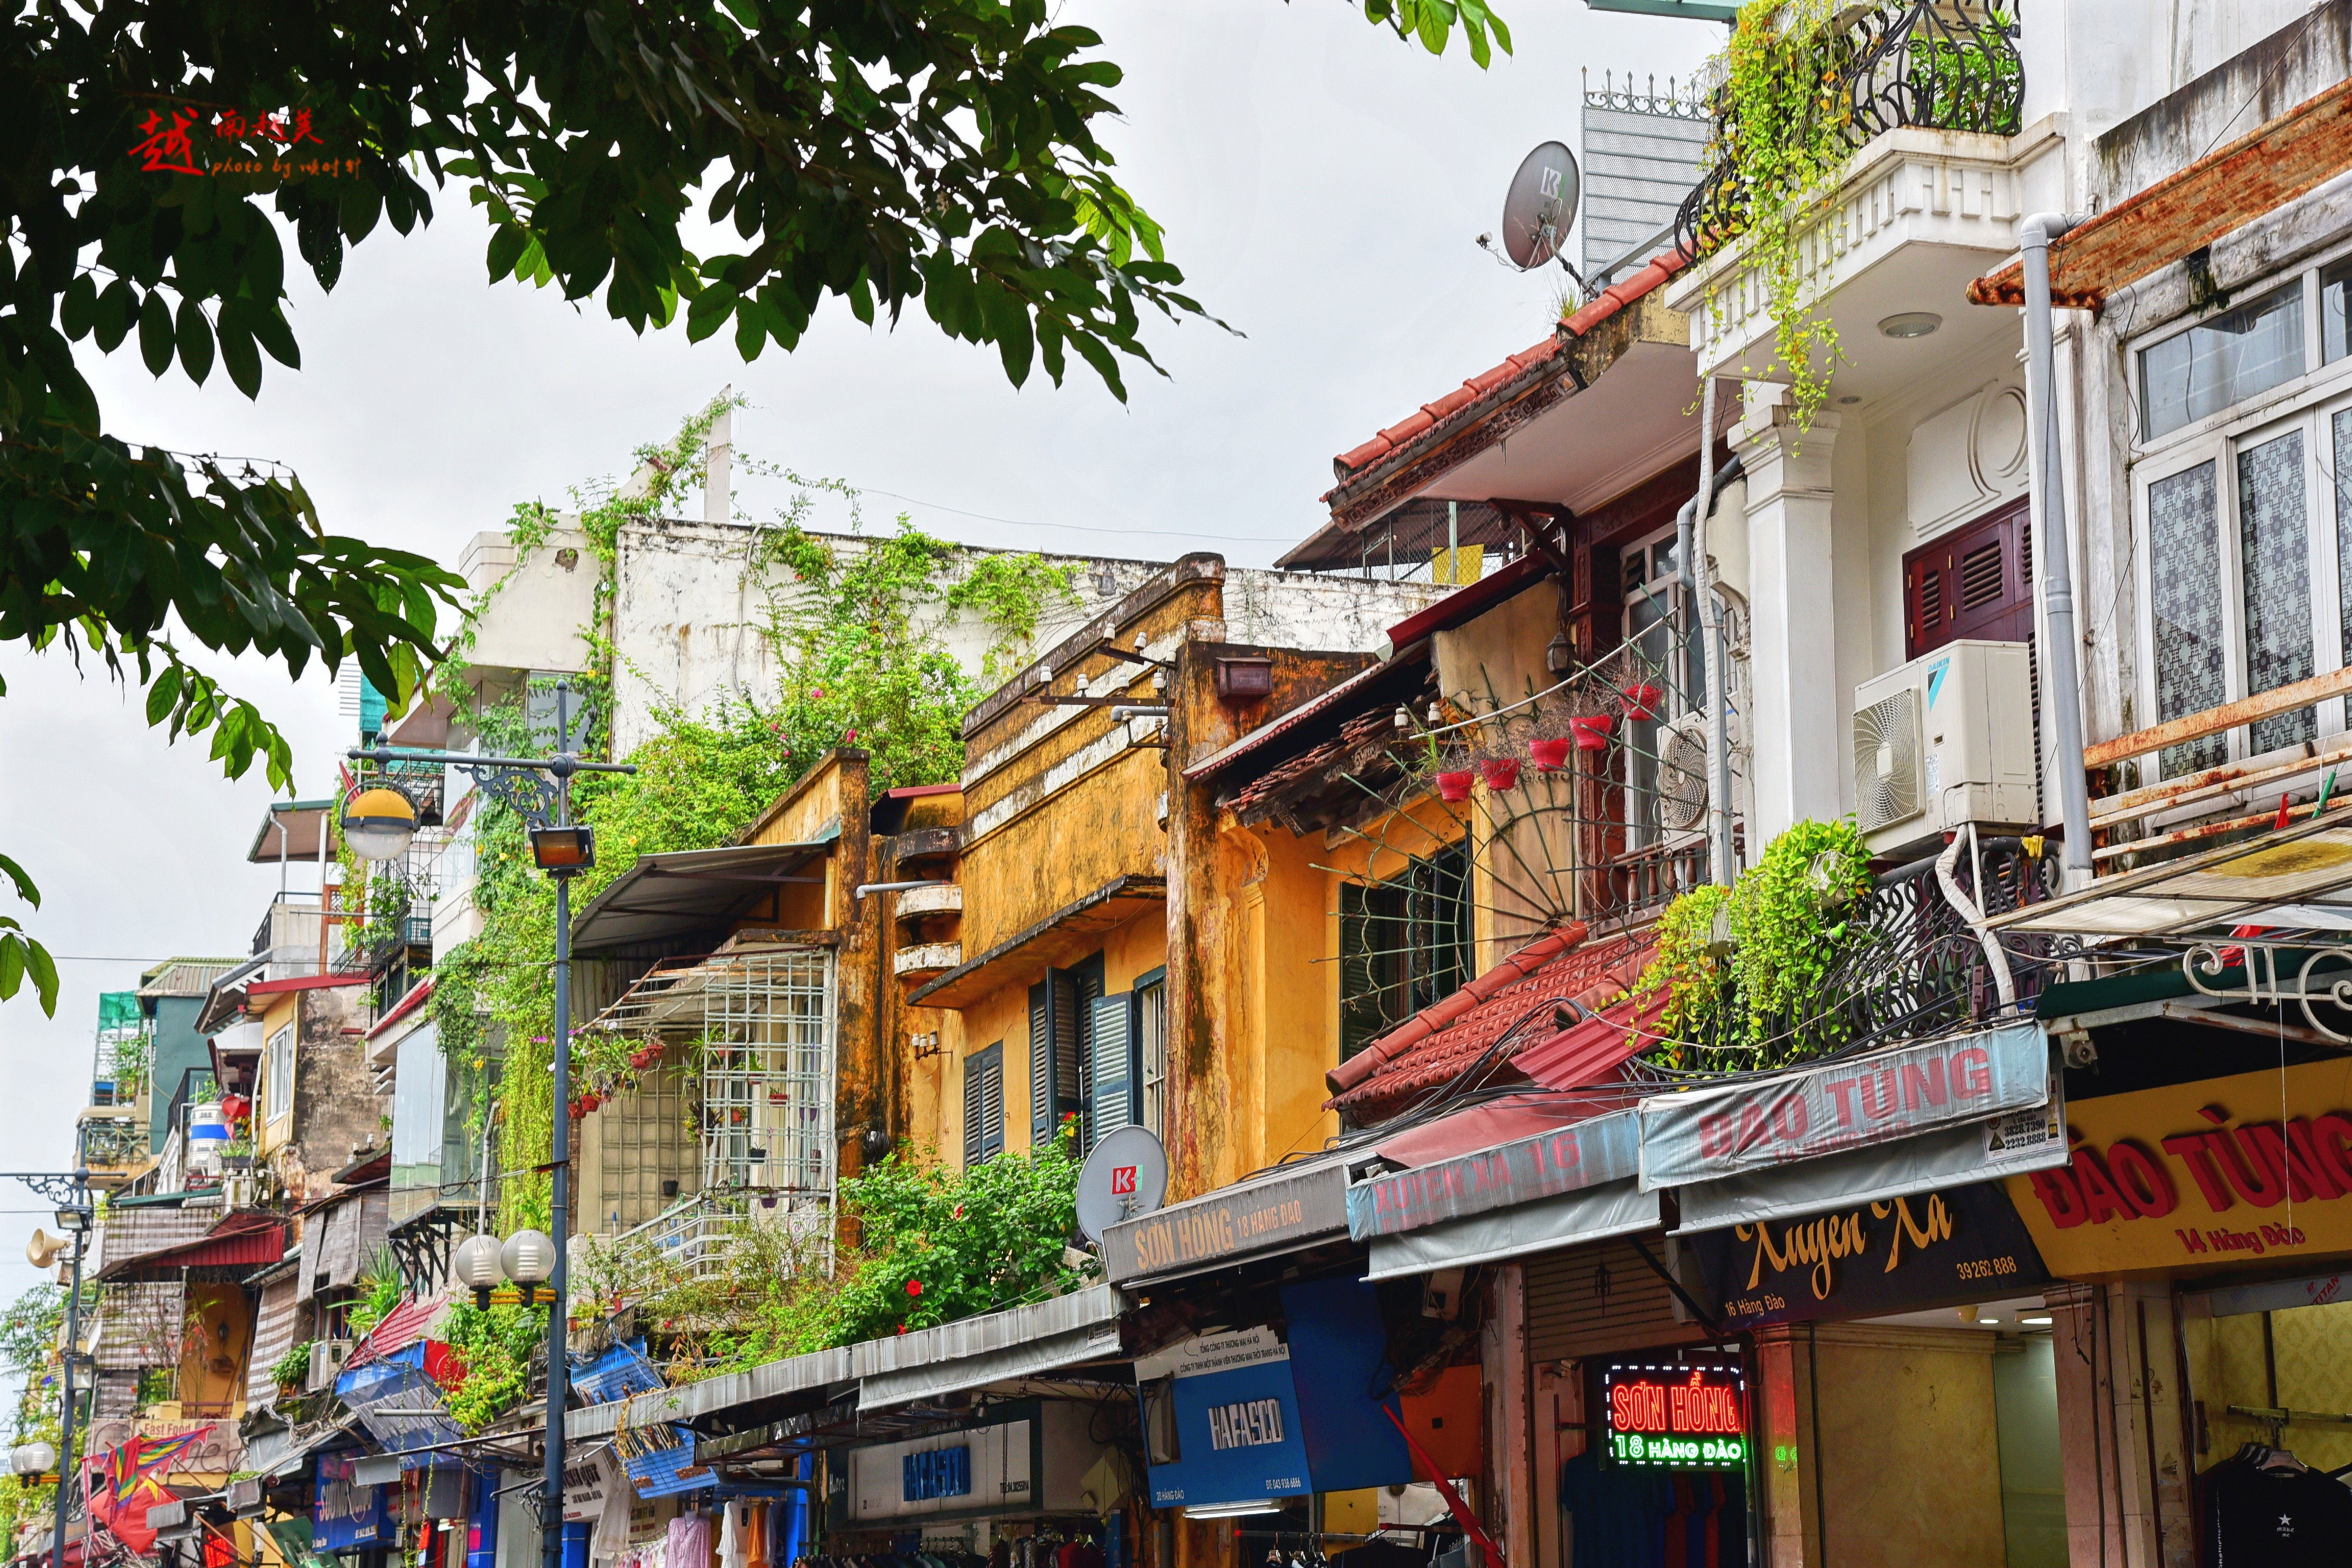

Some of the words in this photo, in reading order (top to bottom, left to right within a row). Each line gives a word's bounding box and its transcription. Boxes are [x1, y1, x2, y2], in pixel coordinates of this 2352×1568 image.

[1928, 656, 1950, 672] DAIKIN
[1699, 1093, 1808, 1159] ĐÀO
[1825, 1047, 1992, 1128] TÙNG
[2005, 1119, 2045, 1137] 3828.7390
[2005, 1132, 2046, 1150] 2232.8888
[1525, 1132, 1581, 1175] 16
[2028, 1125, 2174, 1229] ĐÀO
[1236, 1215, 1250, 1238] 18
[1251, 1205, 1279, 1235] HÀNG
[1735, 1212, 1866, 1300] Xuyen
[1871, 1194, 1952, 1273] Xa
[2175, 1228, 2207, 1254] 14
[2206, 1228, 2265, 1254] Hàng
[2259, 1221, 2306, 1246] Đào
[1725, 1302, 1736, 1317] 16
[1738, 1298, 1763, 1317] Hàng
[1765, 1293, 1785, 1312] Đào
[2313, 1277, 2339, 1305] TITAN
[1614, 1382, 1666, 1431] SƠN
[1671, 1371, 1740, 1432] HỒNG
[144, 1423, 165, 1436] Fast
[167, 1423, 192, 1436] Food
[1208, 1399, 1284, 1450] HAFASCO
[1615, 1435, 1644, 1458] 18
[1648, 1438, 1699, 1459] HÀNG
[1702, 1438, 1742, 1459] ĐÀO
[903, 1446, 971, 1502] HAFASCO
[1273, 1478, 1281, 1489] 043
[1156, 1491, 1162, 1501] 20
[1162, 1488, 1174, 1501] HÀNG
[1174, 1486, 1184, 1500] ĐÀO
